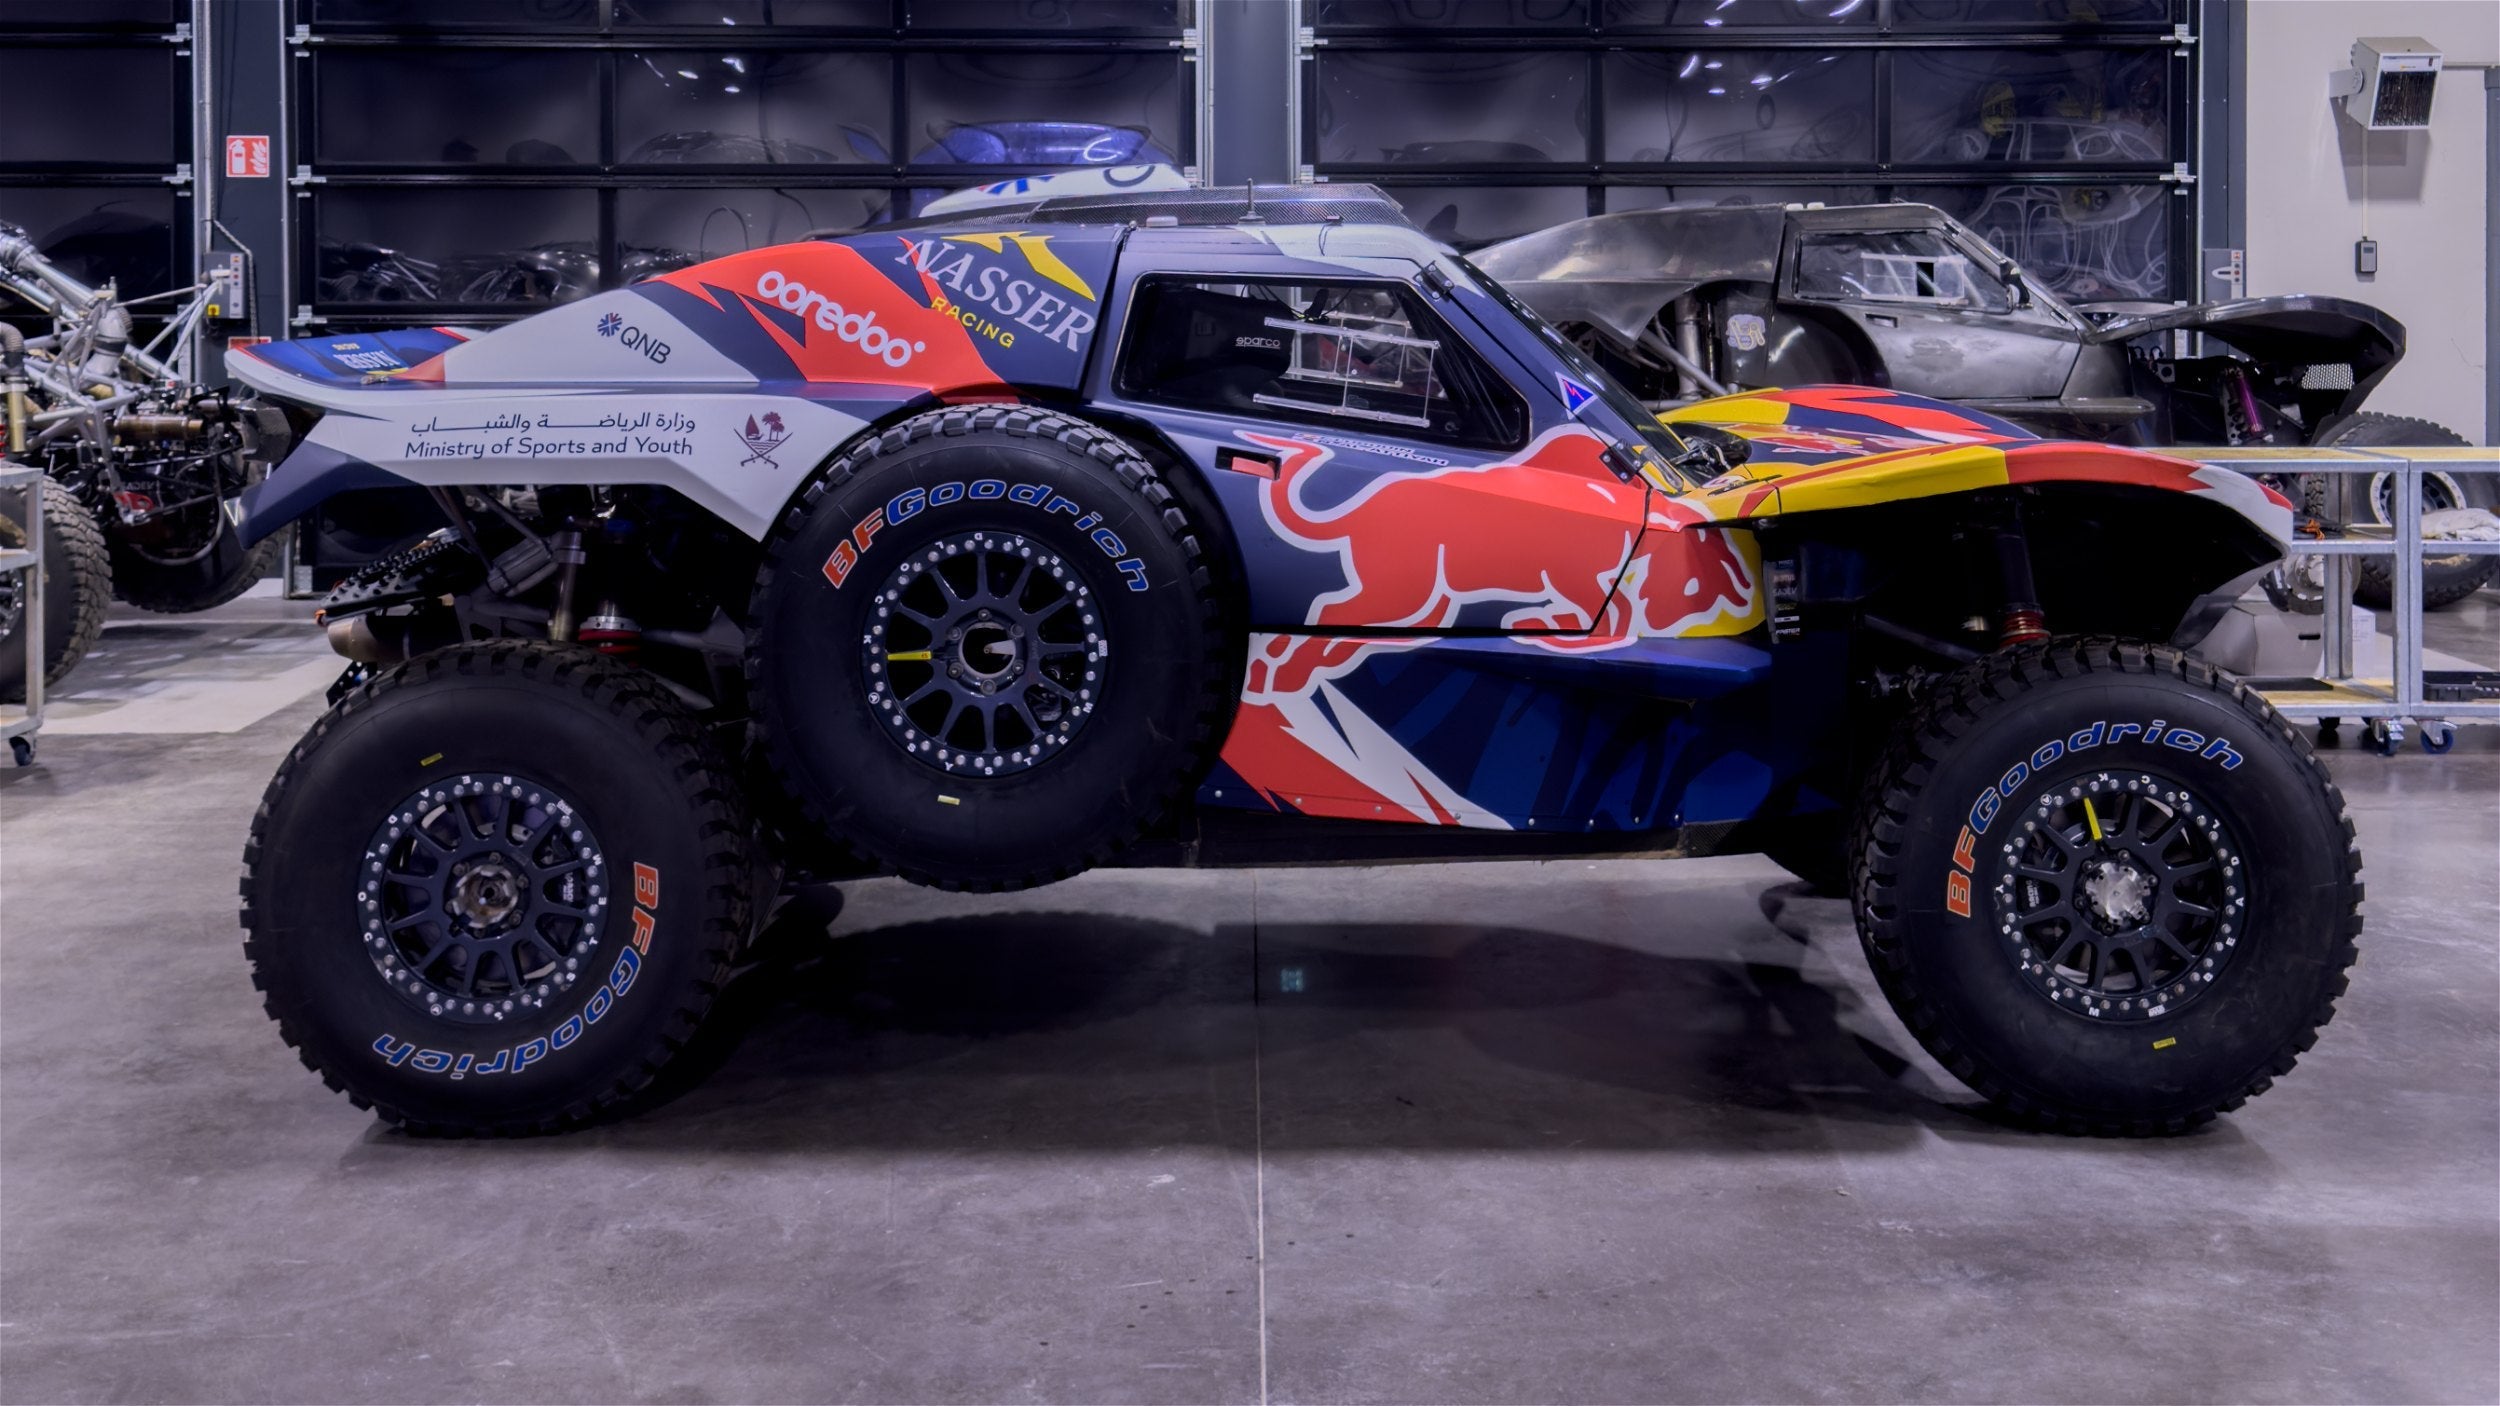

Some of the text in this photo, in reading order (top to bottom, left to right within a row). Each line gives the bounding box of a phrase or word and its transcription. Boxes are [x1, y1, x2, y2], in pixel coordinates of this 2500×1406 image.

[756, 269, 925, 367] ooredoo
[895, 238, 1098, 352] NASSER
[931, 297, 1016, 349] RACING
[620, 326, 671, 365] QNB
[1236, 336, 1280, 350] sparco
[405, 436, 693, 459] Ministry of Sports and Youth
[656, 412, 697, 433] وزارة
[821, 479, 1149, 590] BFGoodrich
[1946, 720, 2246, 918] BFGoodrich
[373, 861, 660, 1080] BFGoodrich
